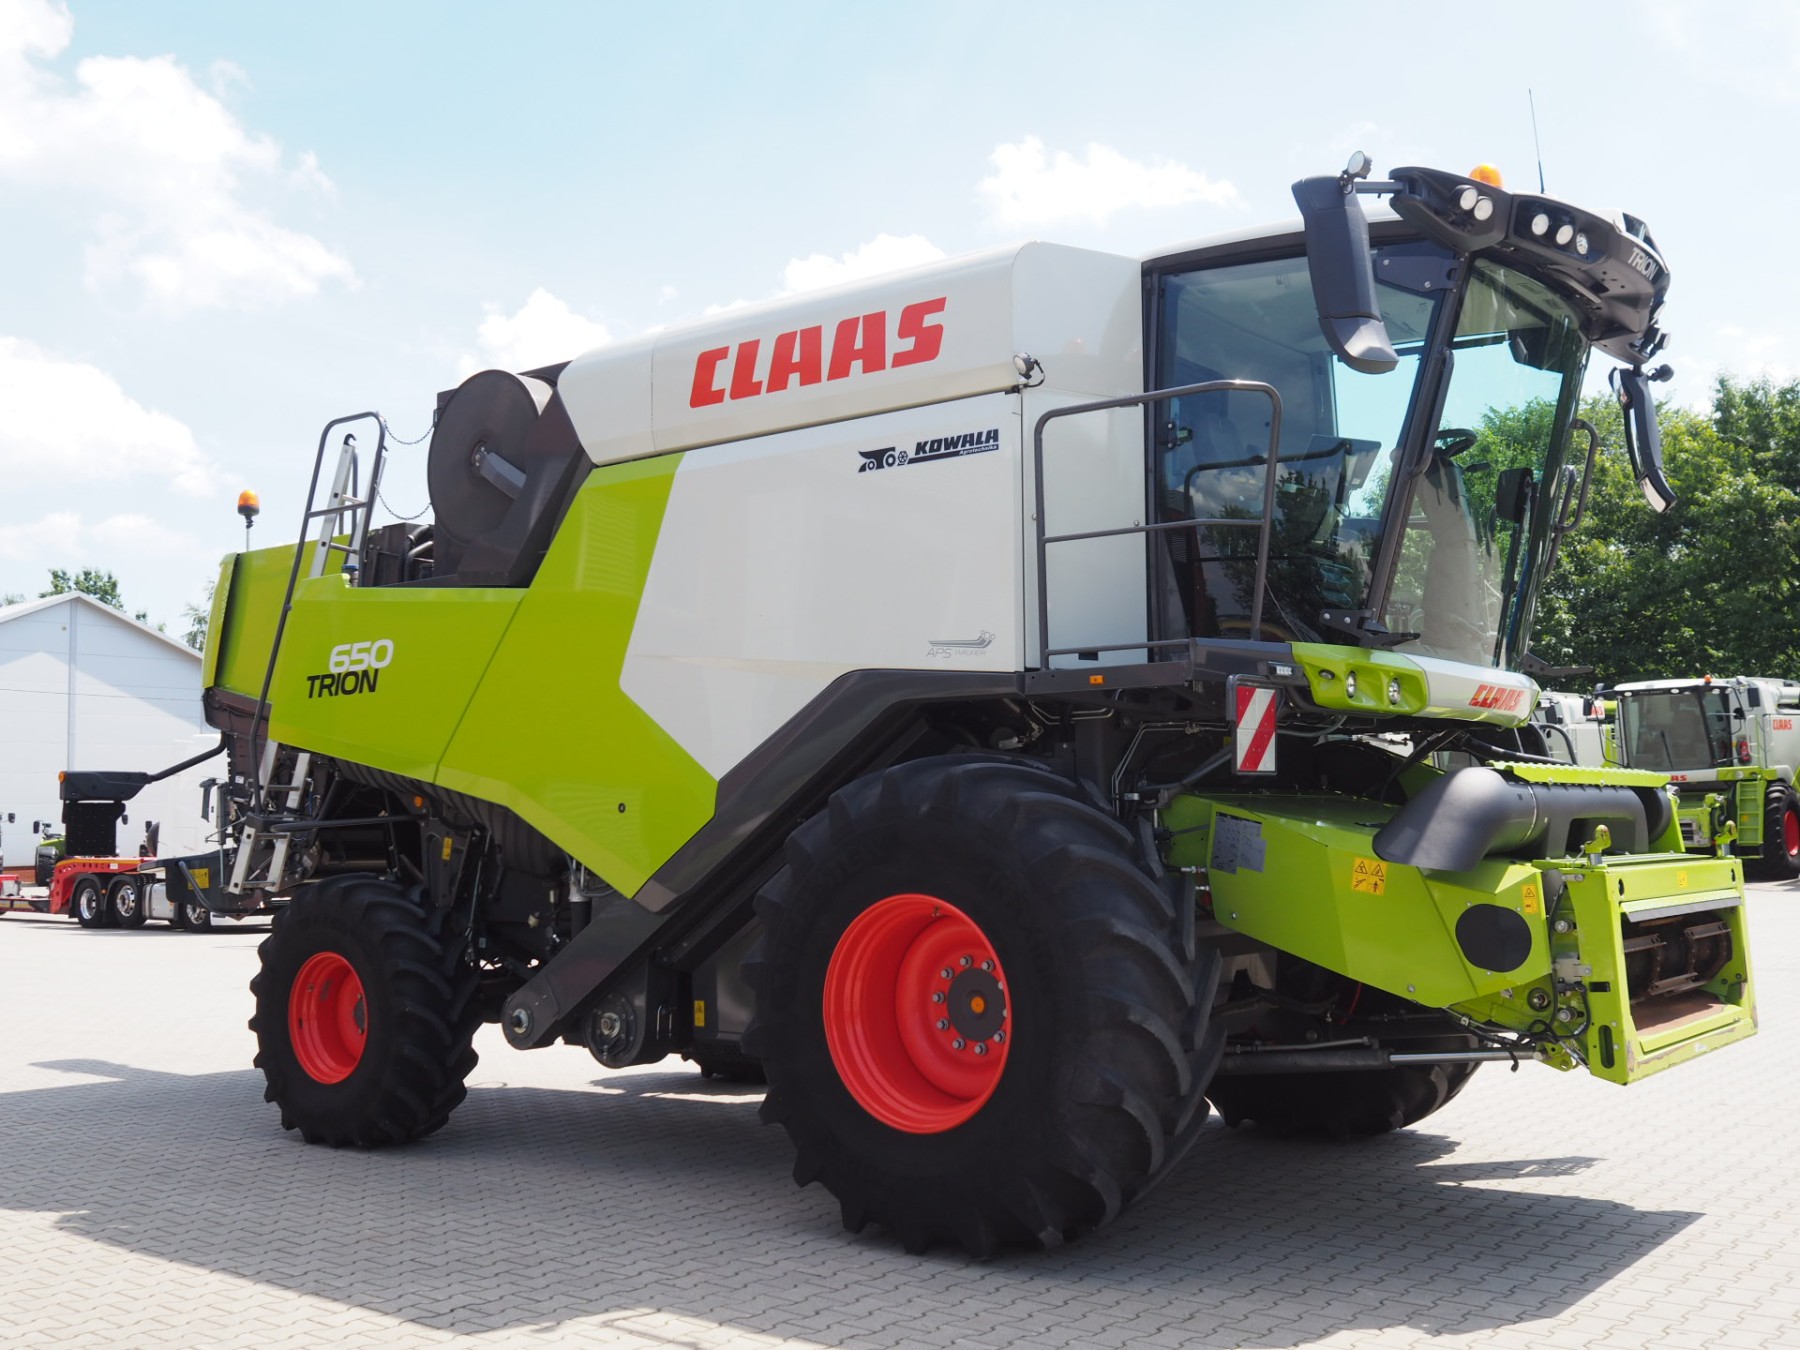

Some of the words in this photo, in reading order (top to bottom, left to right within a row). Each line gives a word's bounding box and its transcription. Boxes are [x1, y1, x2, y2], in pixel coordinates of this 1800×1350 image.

[1627, 246, 1659, 281] TRION
[689, 296, 947, 409] CLAAS
[914, 428, 999, 456] KOWALA
[329, 638, 394, 673] 650
[926, 647, 952, 659] APS
[306, 668, 379, 699] TRION
[1469, 684, 1525, 712] CLAAS
